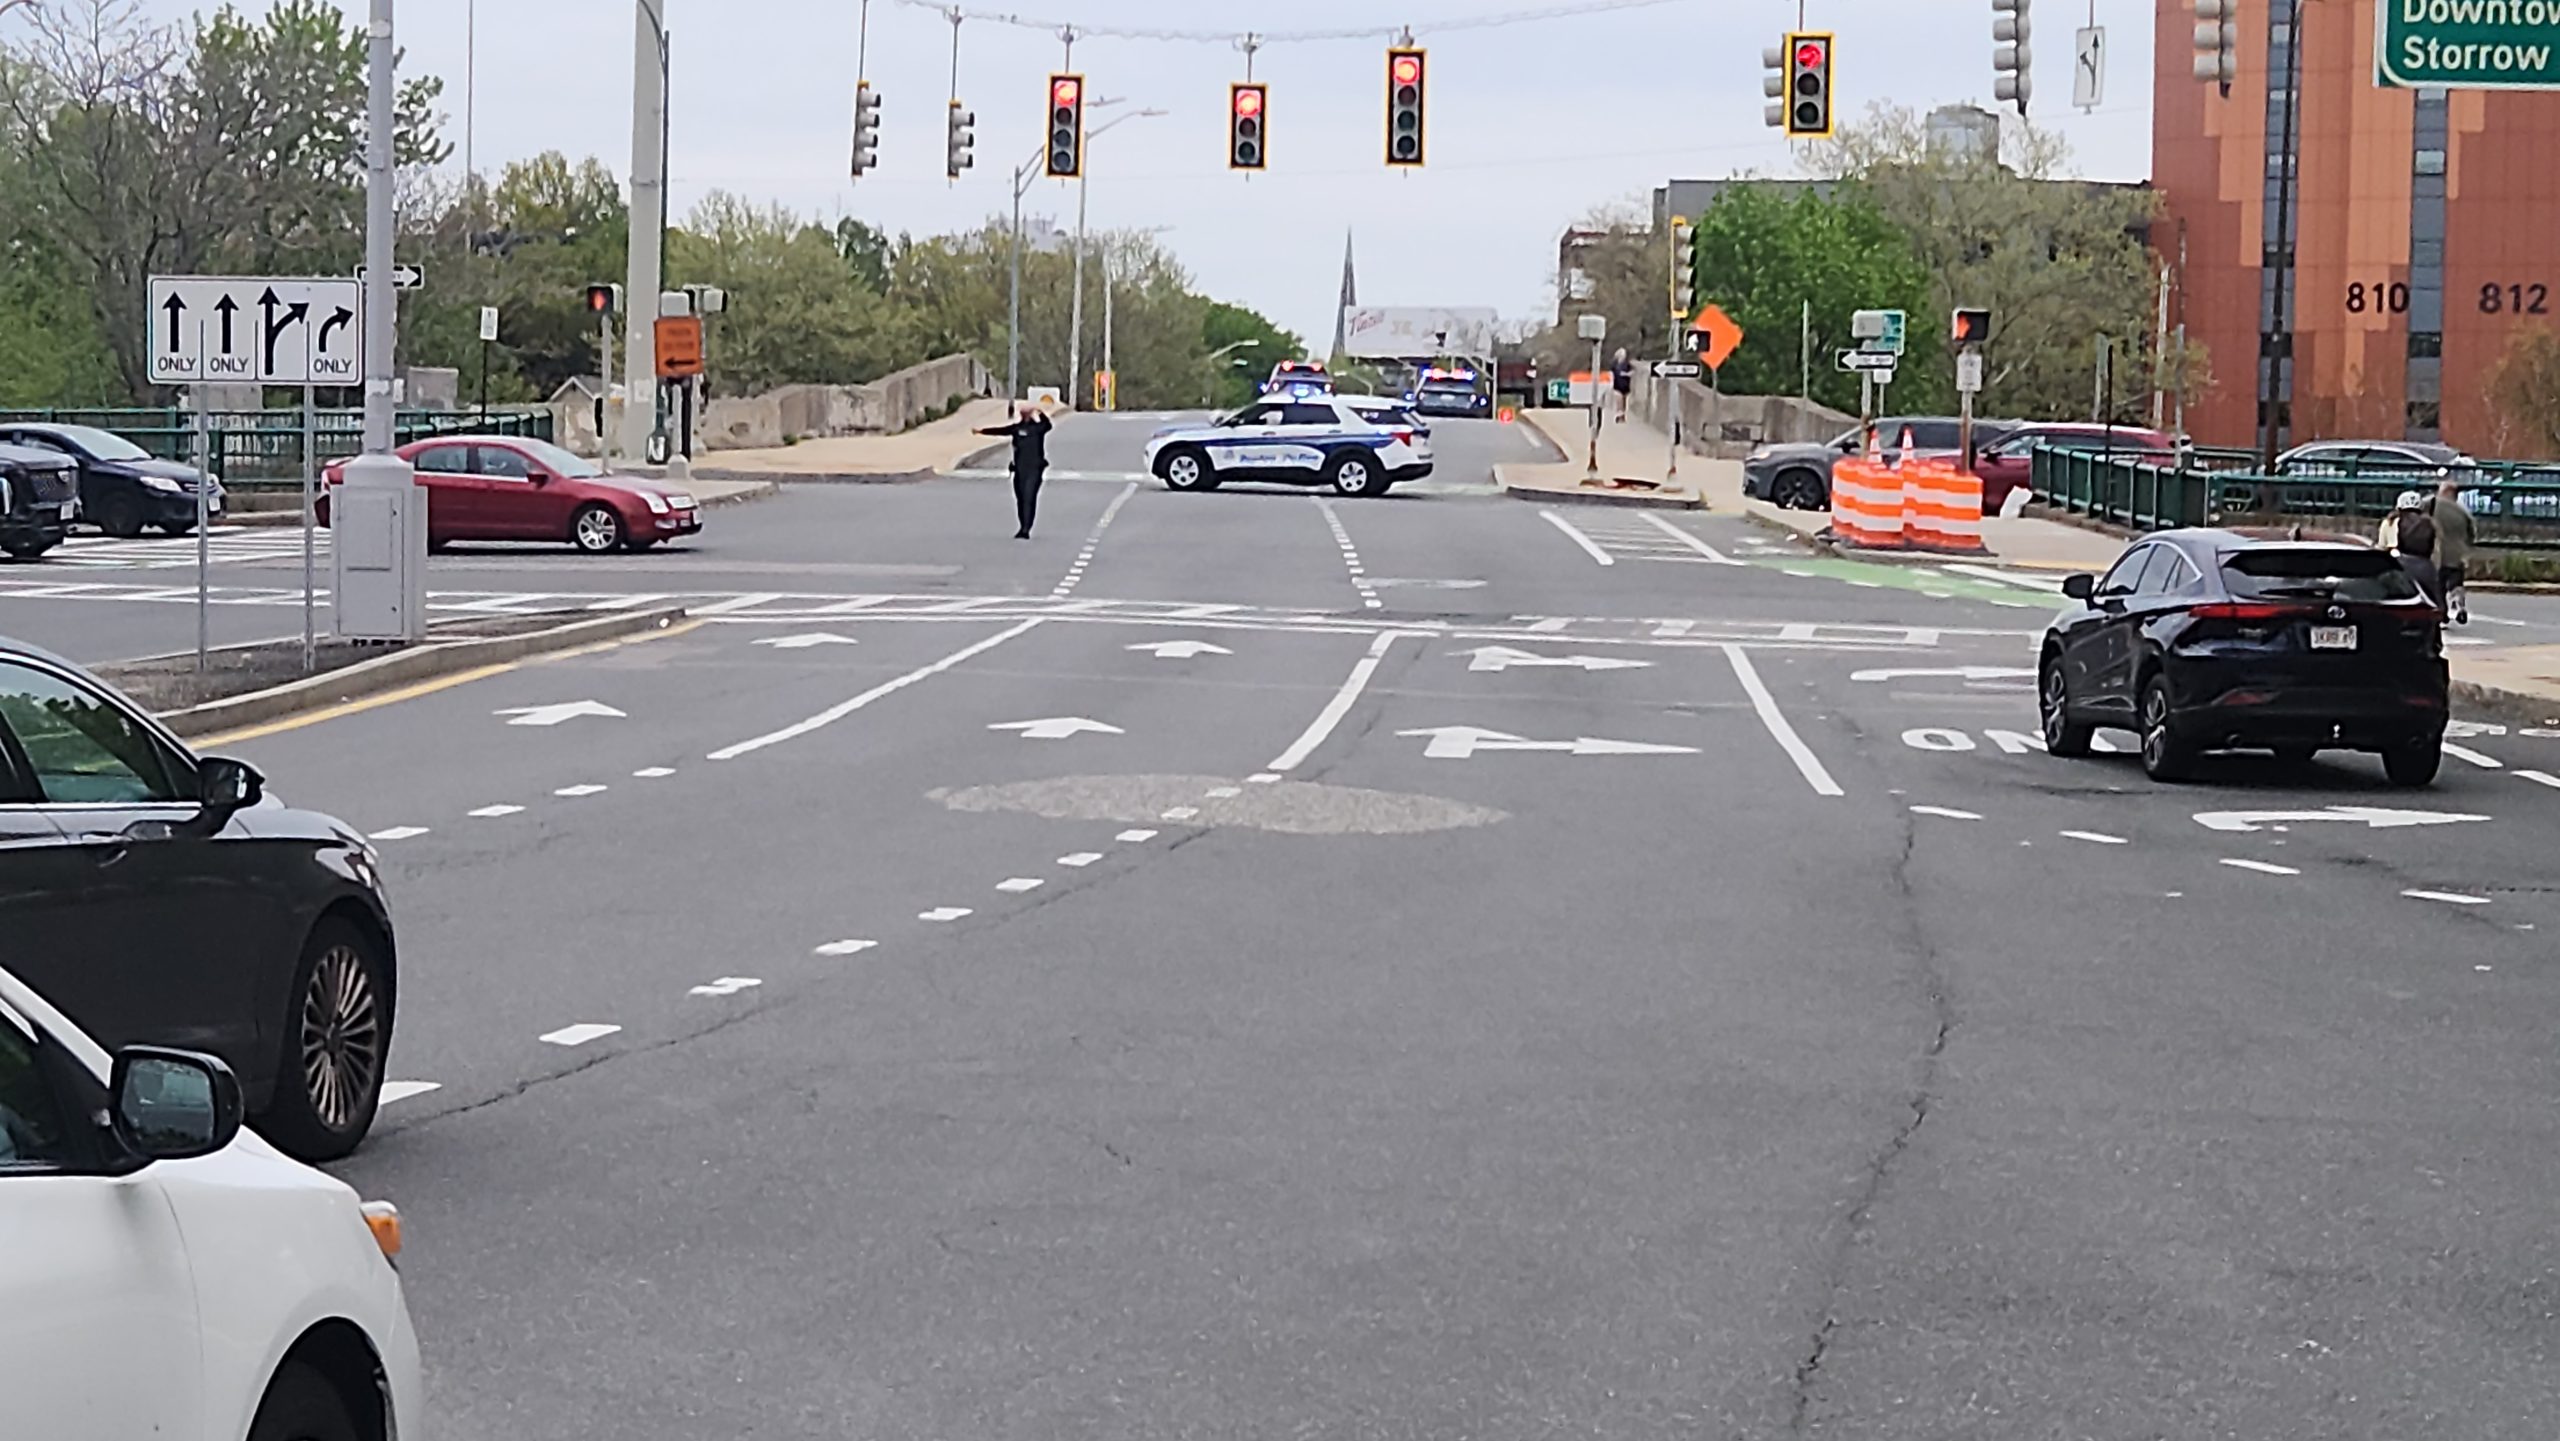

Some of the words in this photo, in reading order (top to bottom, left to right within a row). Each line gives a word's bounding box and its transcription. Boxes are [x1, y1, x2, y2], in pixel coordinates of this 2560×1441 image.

[2403, 35, 2550, 71] Storrow
[2346, 282, 2410, 314] 810
[2478, 282, 2549, 315] 812
[157, 356, 196, 372] ONLY
[210, 356, 249, 373] ONLY
[313, 358, 353, 374] ONLY
